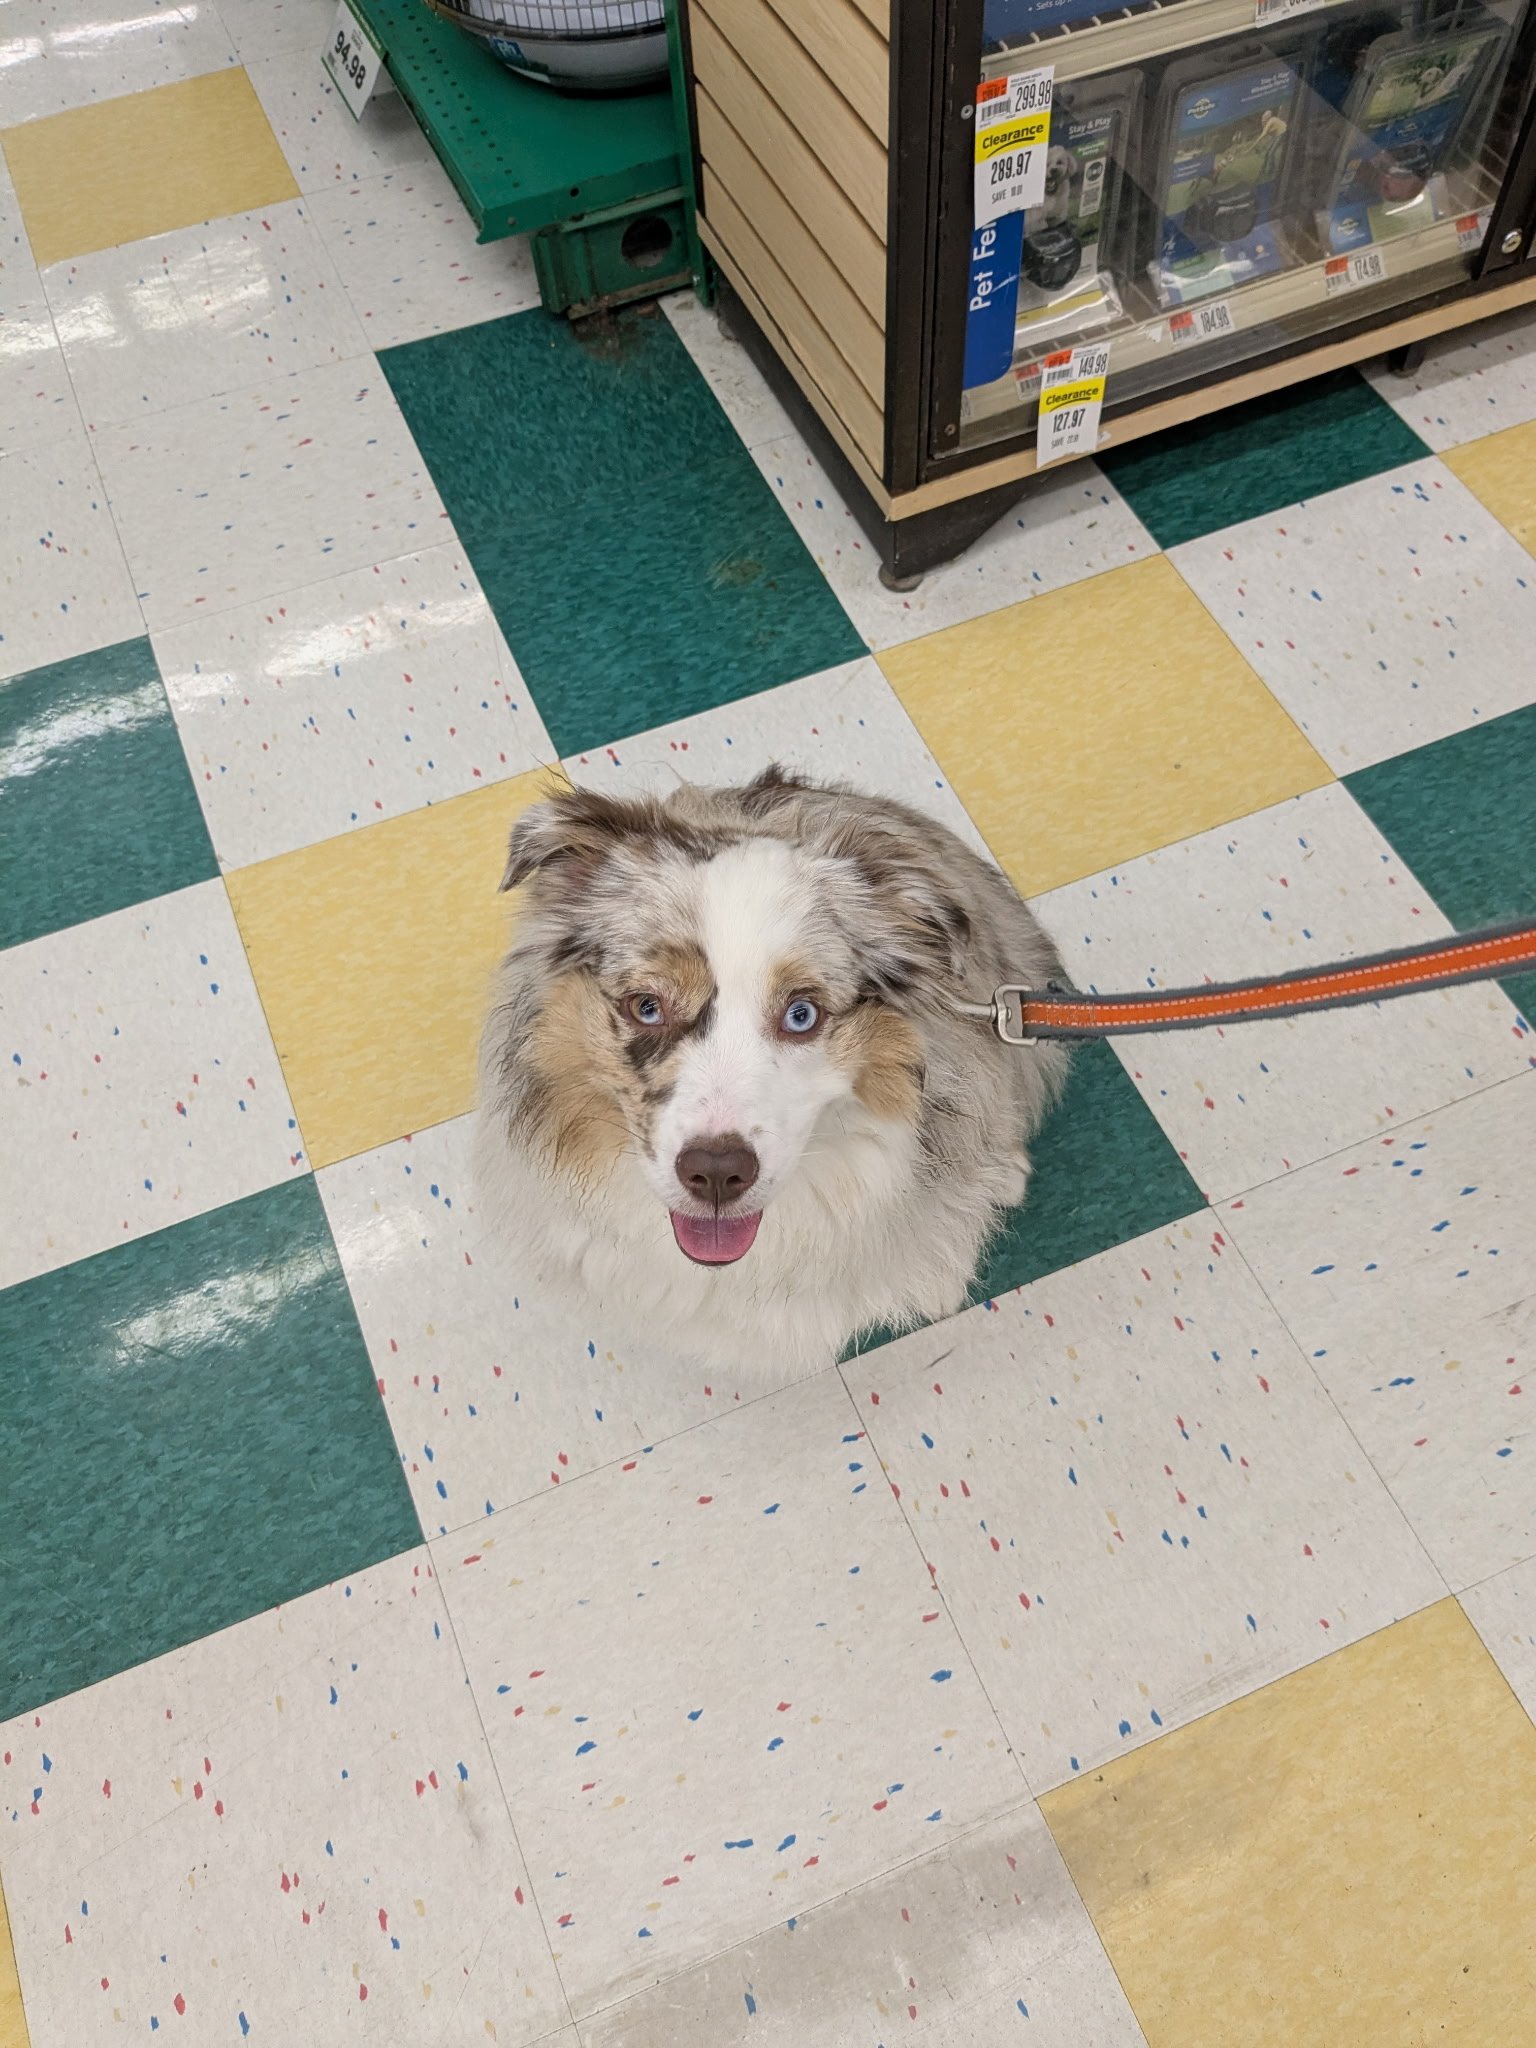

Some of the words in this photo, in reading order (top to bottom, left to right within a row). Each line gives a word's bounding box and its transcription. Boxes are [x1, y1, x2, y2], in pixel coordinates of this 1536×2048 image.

[334, 30, 366, 89] 94.98
[1015, 80, 1052, 112] 299.98
[982, 124, 1044, 149] Clearance
[1069, 125, 1086, 135] Stay
[991, 151, 1032, 185] 289.97
[992, 189, 1007, 204] SAVE
[1354, 255, 1381, 281] 174.98
[969, 271, 993, 312] Pet
[1201, 305, 1230, 333] 184.98
[1079, 353, 1108, 377] 149.98
[1046, 387, 1099, 405] Clearance
[1053, 408, 1086, 433] 127.97
